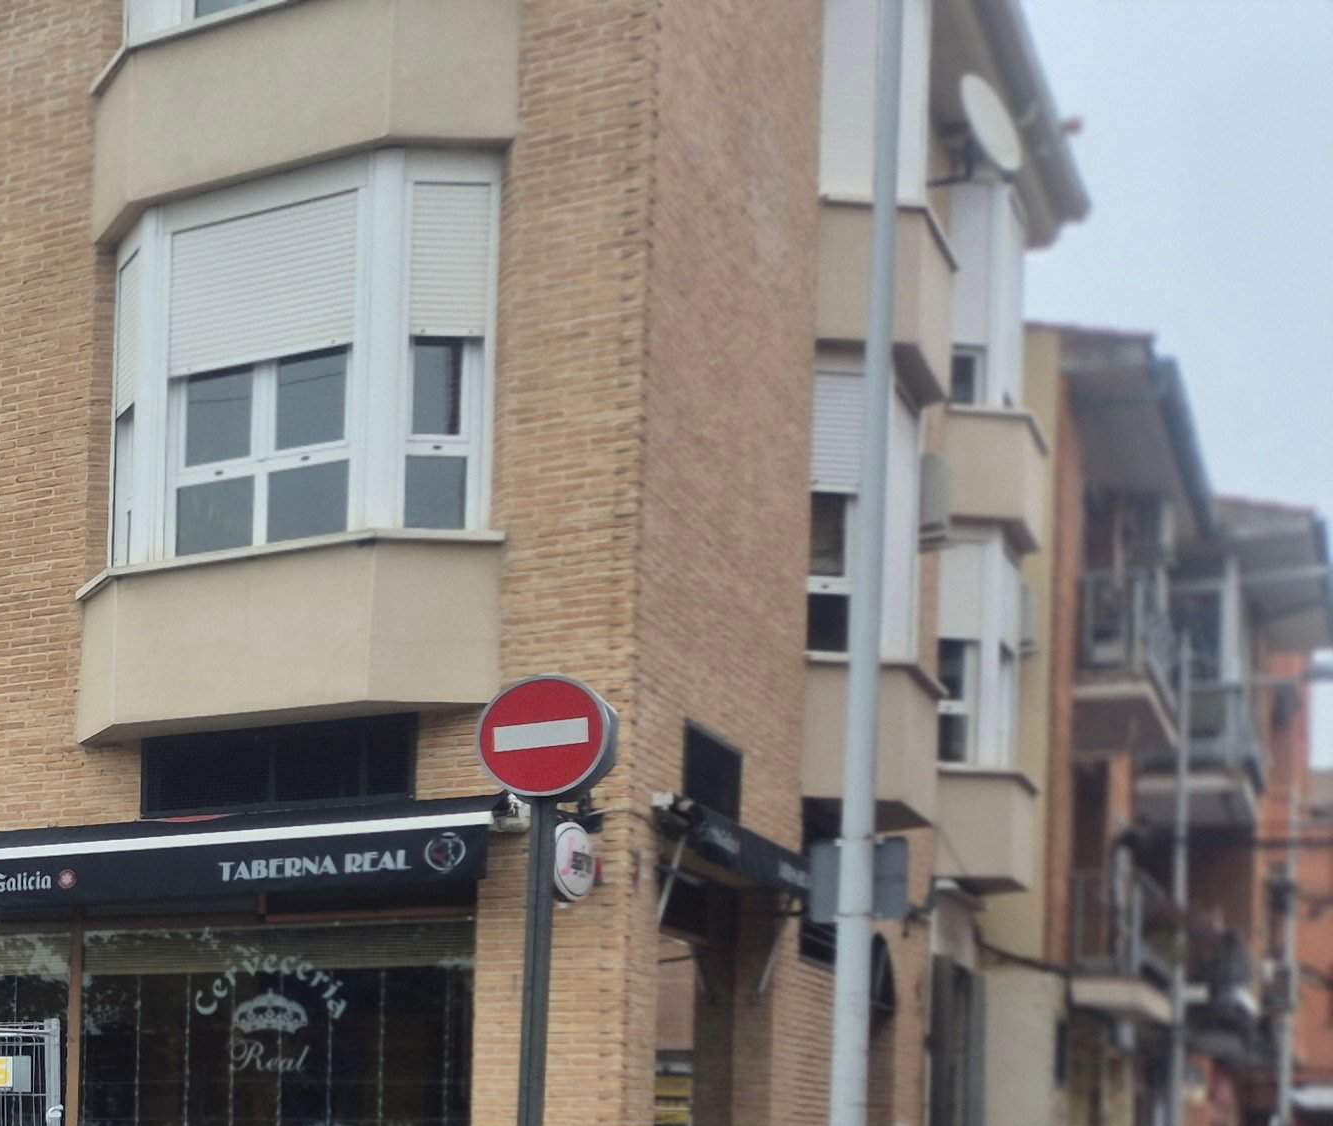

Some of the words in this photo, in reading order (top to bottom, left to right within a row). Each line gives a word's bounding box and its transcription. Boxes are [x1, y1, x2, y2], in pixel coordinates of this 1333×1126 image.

[219, 854, 336, 882] TABERNA
[344, 850, 412, 873] REAL
[230, 1039, 310, 1072] Real
